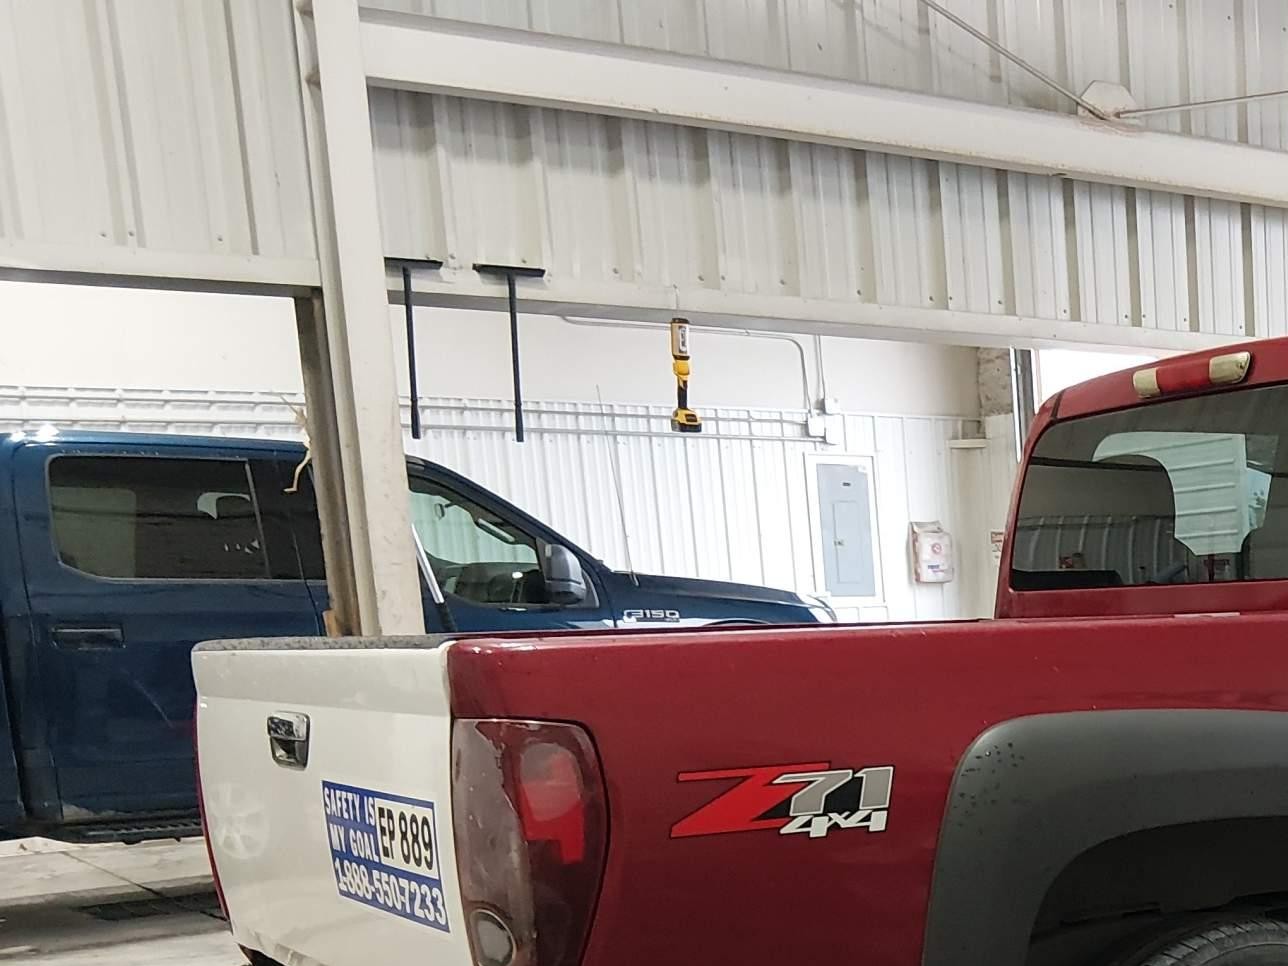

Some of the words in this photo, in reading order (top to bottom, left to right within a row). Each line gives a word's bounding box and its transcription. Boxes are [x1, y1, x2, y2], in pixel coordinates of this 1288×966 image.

[323, 787, 360, 823] SAFETY
[364, 795, 376, 826] IS
[670, 761, 895, 838] Z71
[329, 823, 346, 853] MY
[349, 828, 380, 863] GOAL
[377, 806, 395, 860] EP
[398, 810, 434, 871] 889
[334, 857, 447, 926] 1-888-550-7233
